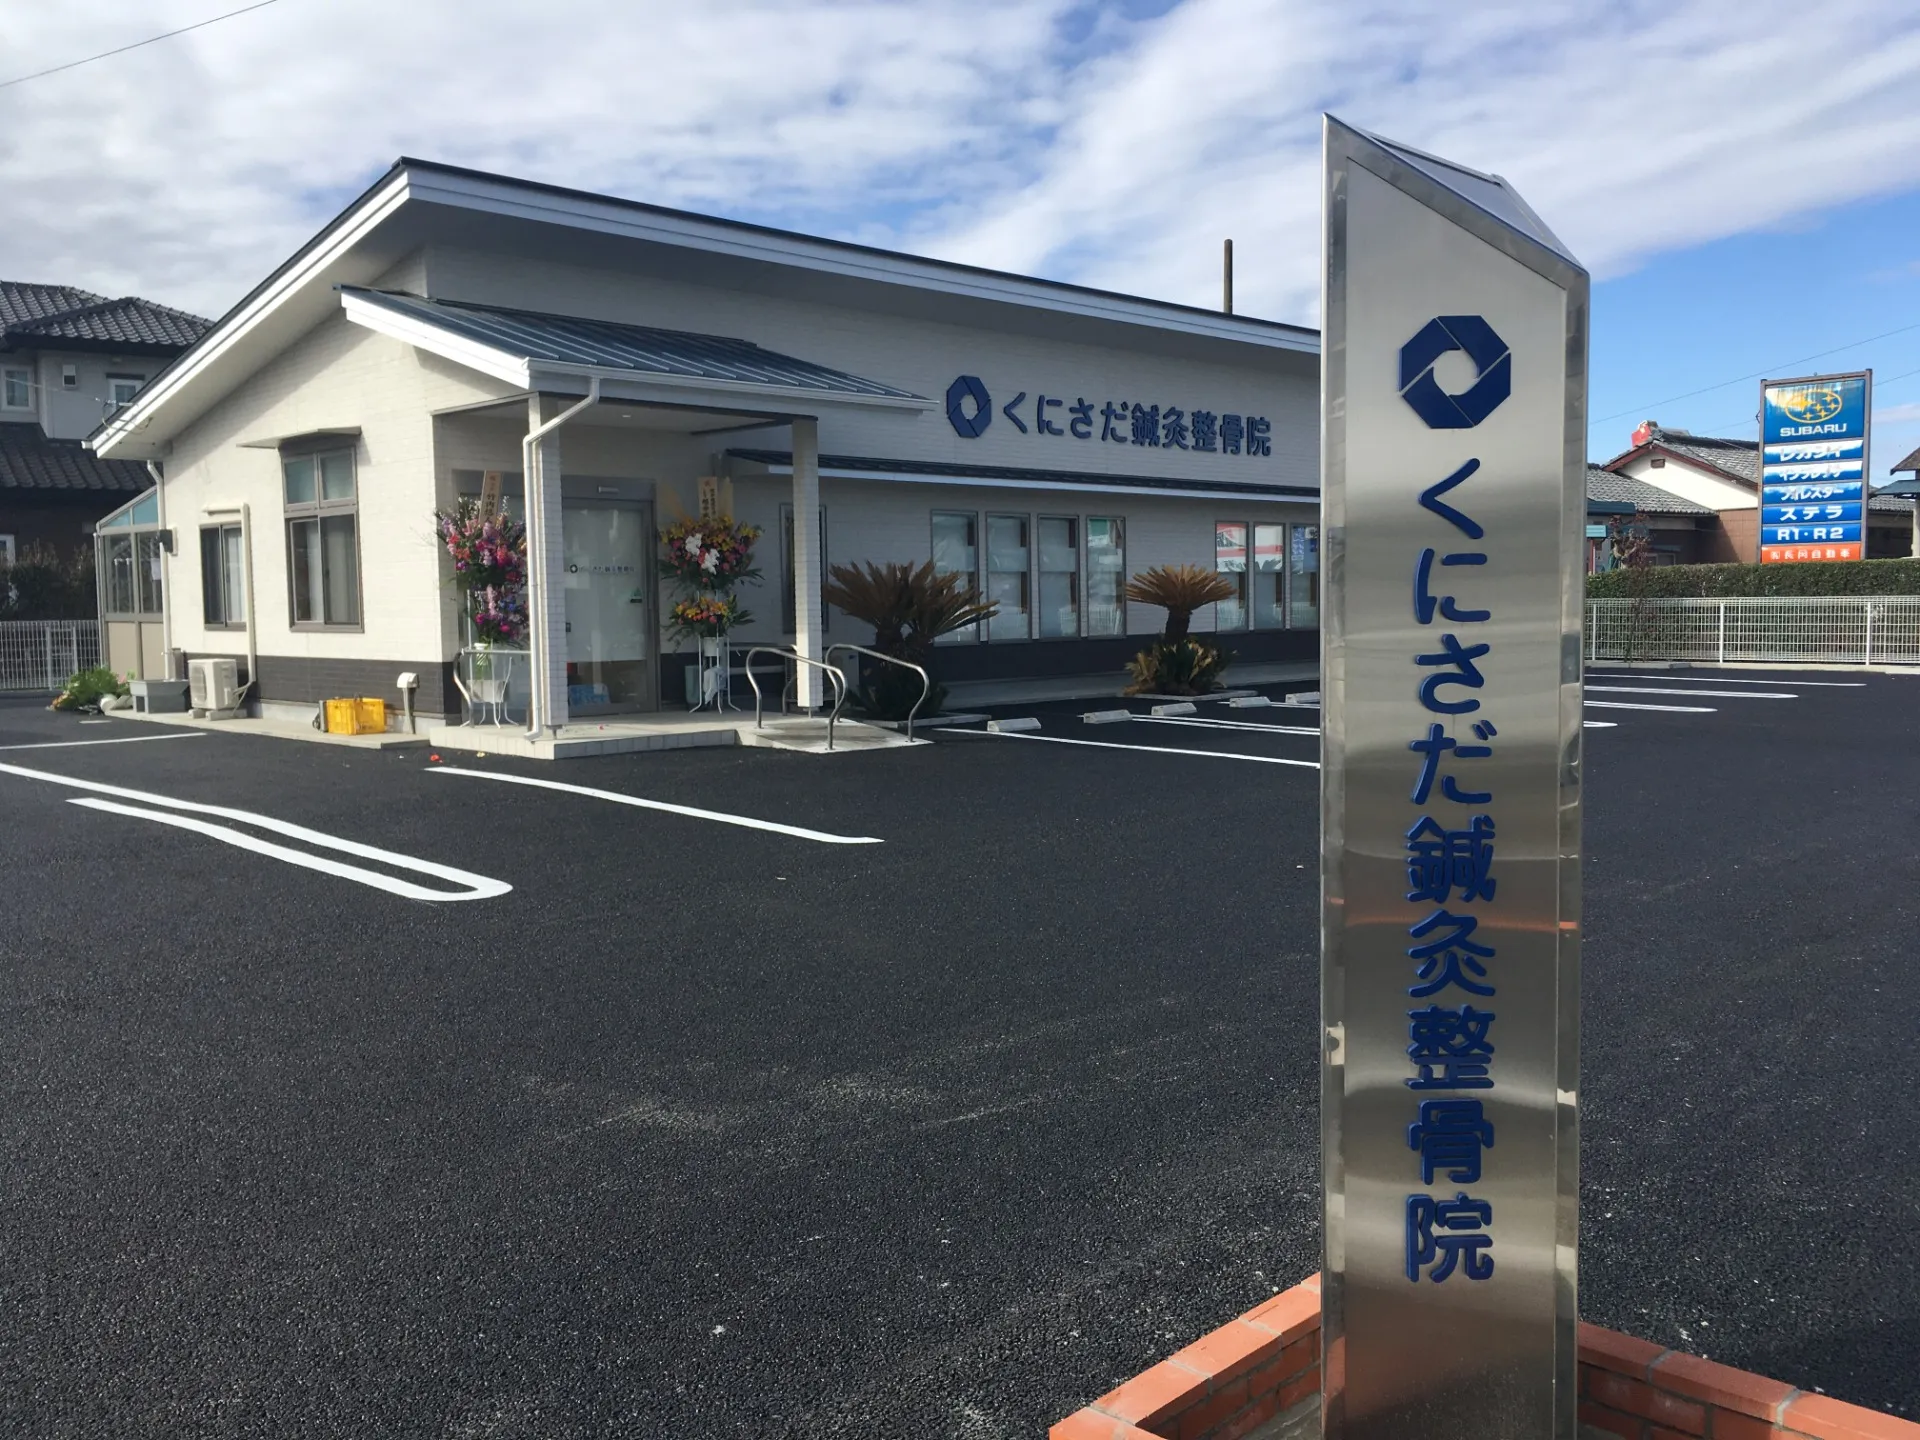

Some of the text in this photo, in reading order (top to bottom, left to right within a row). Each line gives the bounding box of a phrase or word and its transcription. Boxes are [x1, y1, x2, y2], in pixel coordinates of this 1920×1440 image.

[1003, 391, 1272, 456] くにさだ鍼灸整骨院
[1780, 423, 1847, 437] SUBARU
[1780, 505, 1843, 521] ステラ
[1405, 457, 1498, 1283] くにさだ鍼灸整骨院
